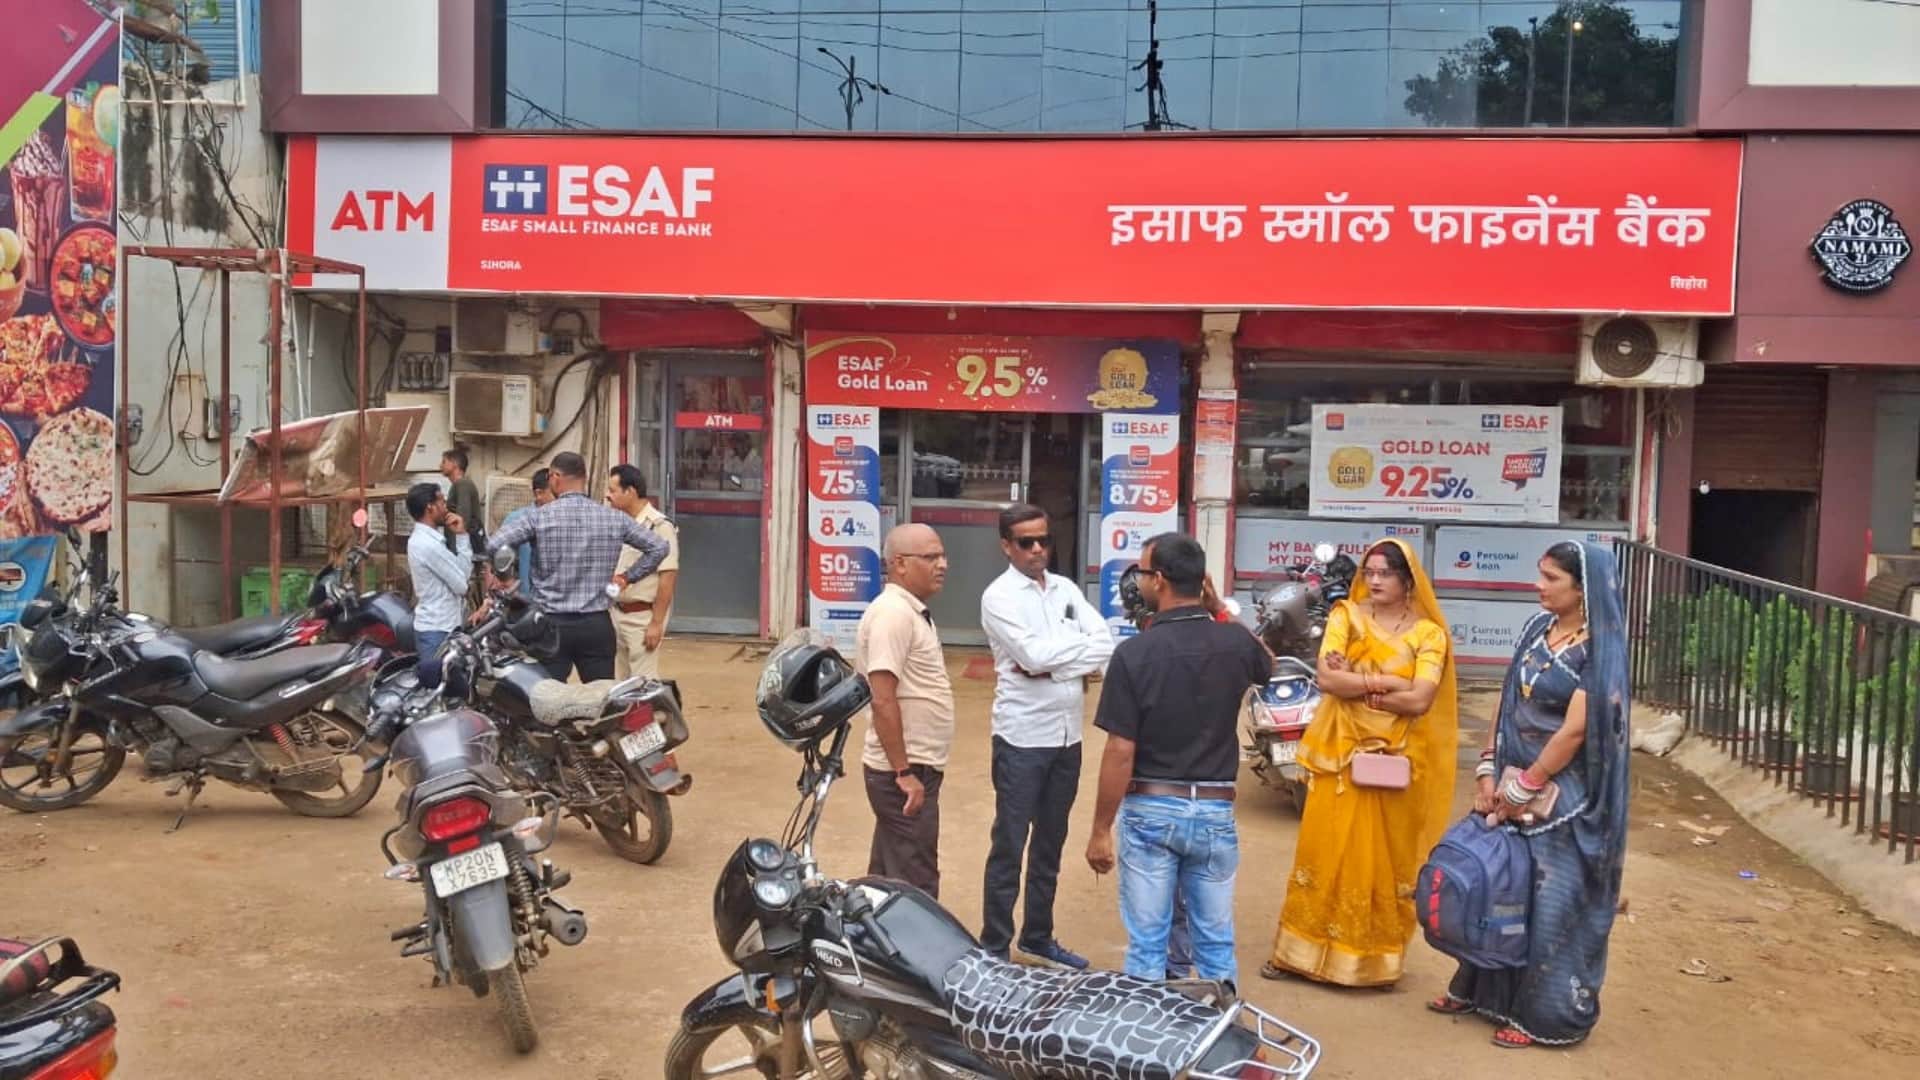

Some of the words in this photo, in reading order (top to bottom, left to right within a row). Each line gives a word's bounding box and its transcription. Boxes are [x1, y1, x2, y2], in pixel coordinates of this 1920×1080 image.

[557, 165, 714, 218] ESAF
[330, 189, 434, 231] ATM
[1107, 204, 1247, 246] इसाफ
[1259, 191, 1394, 243] स्मॉल
[1408, 194, 1600, 248] फाइनेंस
[1614, 193, 1711, 248] बैंक
[1860, 218, 1871, 229] N
[481, 218, 519, 232] ESAF
[523, 220, 577, 233] SMALL
[583, 221, 659, 235] FINANCE
[664, 222, 712, 236] BANK
[1824, 239, 1902, 255] NAMAMI
[838, 355, 885, 371] ESAF
[838, 374, 880, 390] Gold
[885, 375, 928, 391] Loan
[704, 414, 733, 427] ATM
[834, 413, 871, 425] ESAF
[1504, 414, 1549, 429] ESAF
[1130, 422, 1169, 434] ESAF
[1381, 440, 1434, 454] GOLD
[1440, 440, 1490, 456] LOAN
[1337, 465, 1365, 475] GOLD
[1380, 464, 1474, 498] 9.25%
[1397, 527, 1421, 535] ESAF
[1268, 541, 1290, 552] MY
[1268, 555, 1290, 565] MY
[1477, 551, 1519, 560] Personal
[1477, 562, 1501, 571] Loan
[1471, 625, 1512, 635] Current
